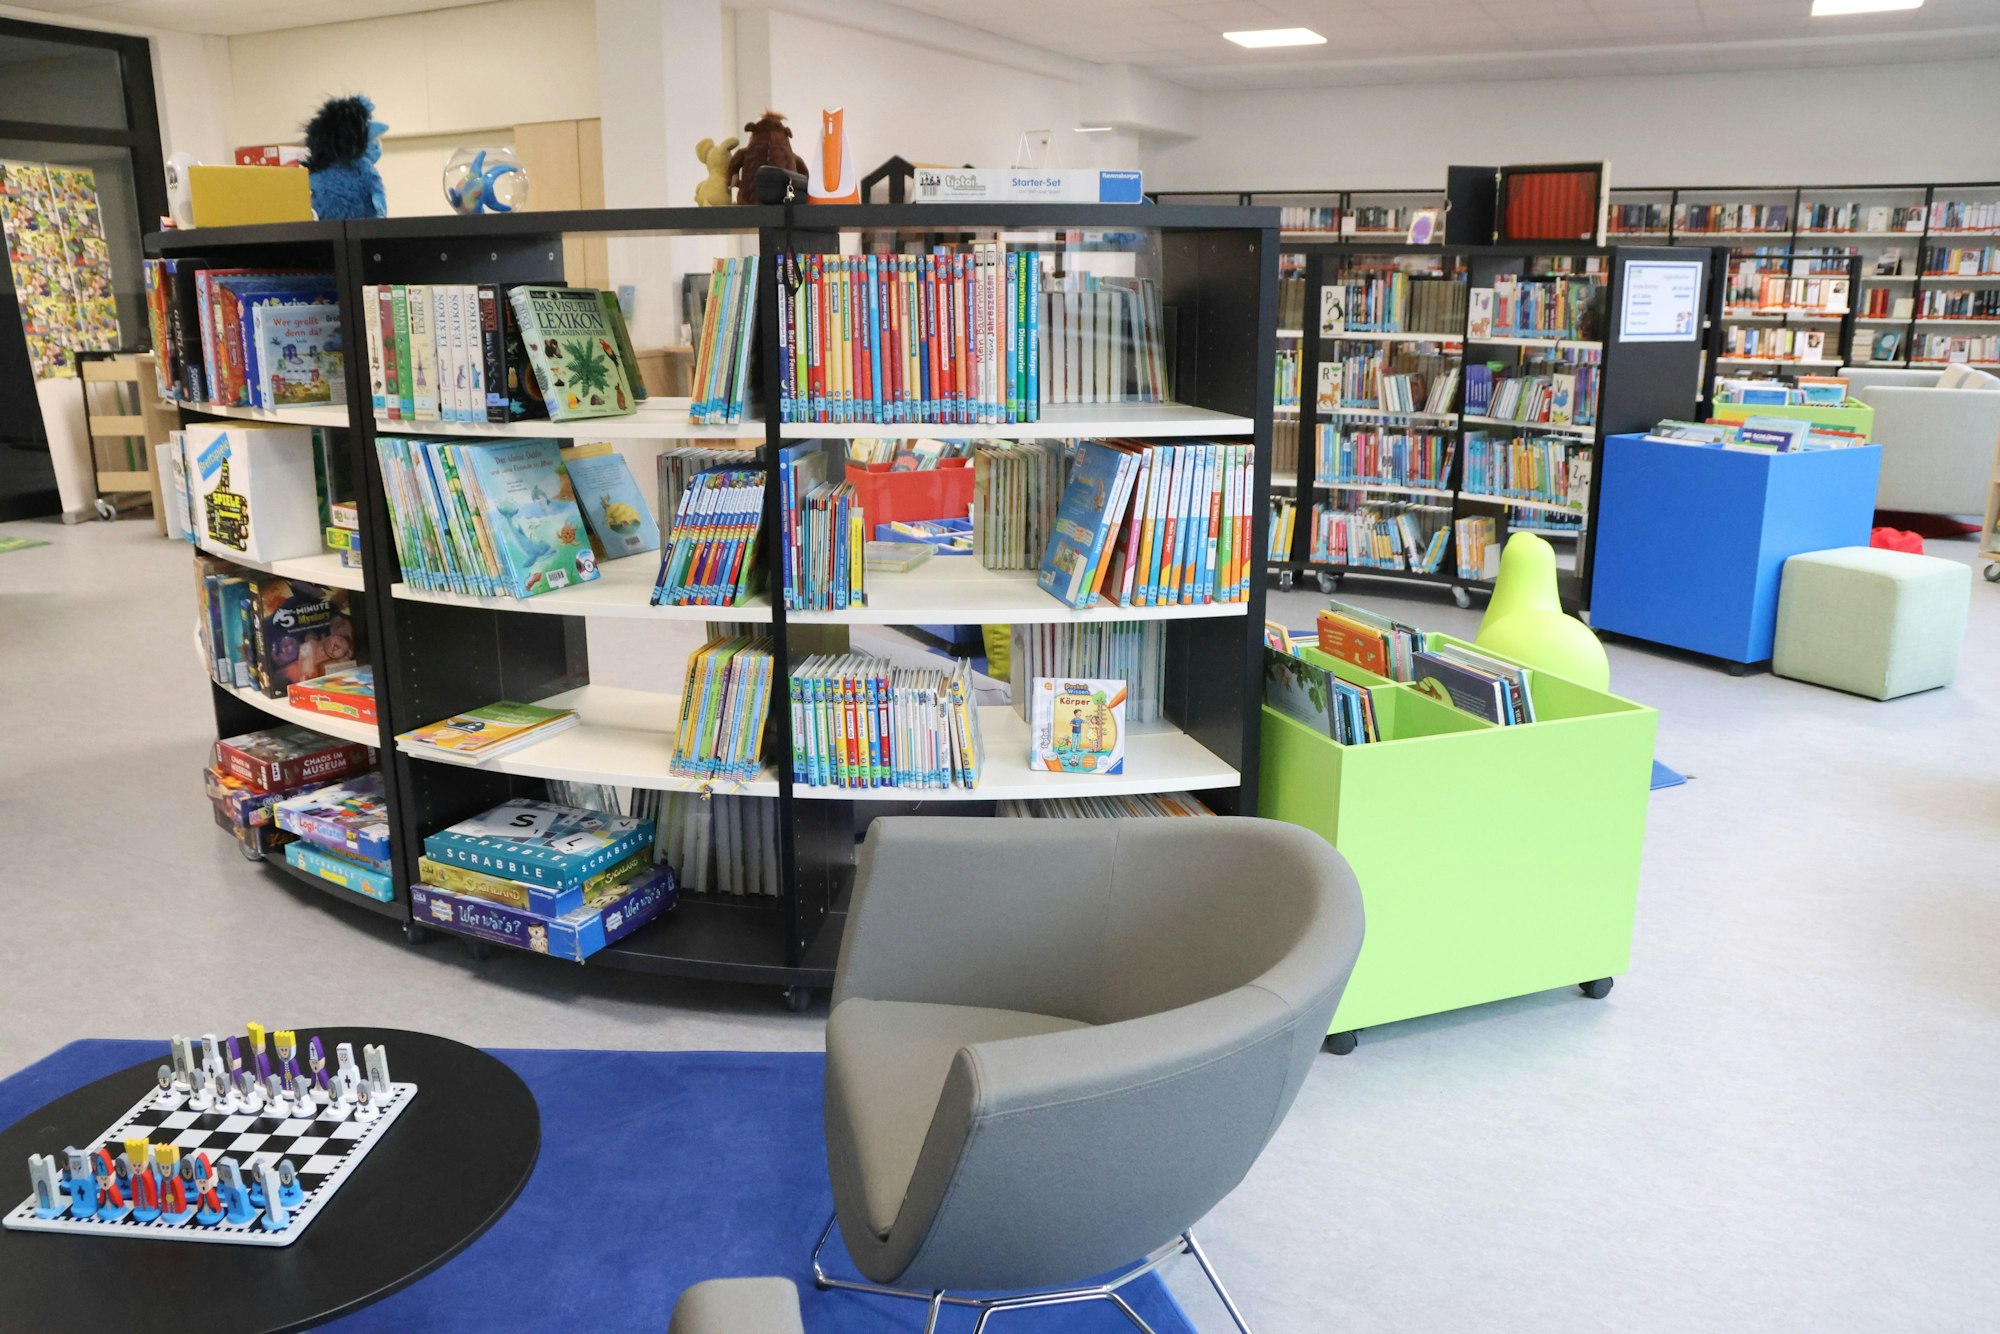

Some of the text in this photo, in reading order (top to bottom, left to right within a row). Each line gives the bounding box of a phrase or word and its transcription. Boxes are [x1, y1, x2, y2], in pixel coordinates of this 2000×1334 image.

[1012, 178, 1061, 187] Starter-Set
[1102, 172, 1139, 180] Ravensburger
[1018, 257, 1026, 322] MiniMaxiWissen
[1030, 257, 1038, 323] MiniMaxiWissen
[1325, 291, 1332, 304] P
[533, 301, 600, 312] DAS VISUELLE
[987, 275, 995, 337] Jahreszeiten
[1474, 293, 1480, 306] T
[295, 317, 319, 328] grollt
[437, 294, 447, 347] LEXIKON
[452, 294, 461, 347] LEXIKON
[469, 293, 478, 347] LEXIKON
[537, 312, 603, 329] LEXIKON
[976, 279, 985, 364] Mein Bauernhof
[285, 328, 322, 337] denn da?
[1322, 367, 1330, 380] R
[191, 368, 201, 402] KOSMOS
[1556, 380, 1563, 392] V
[212, 492, 240, 507] SPIELE
[1060, 698, 1091, 706] Körper
[231, 756, 244, 766] CHAOS
[304, 752, 343, 767] CHAOS IM
[231, 763, 252, 779] MUSEUM
[303, 759, 347, 777] MUSEUM
[509, 815, 538, 828] S
[450, 834, 564, 862] SCRABBLE
[566, 837, 583, 847] L
[582, 833, 644, 872] SCRABBLE
[447, 848, 543, 878] SCRABBLE
[604, 859, 639, 884] SAGALAND
[624, 897, 640, 918] Wer
[458, 905, 480, 925] Wer
[482, 915, 522, 935] war's?
